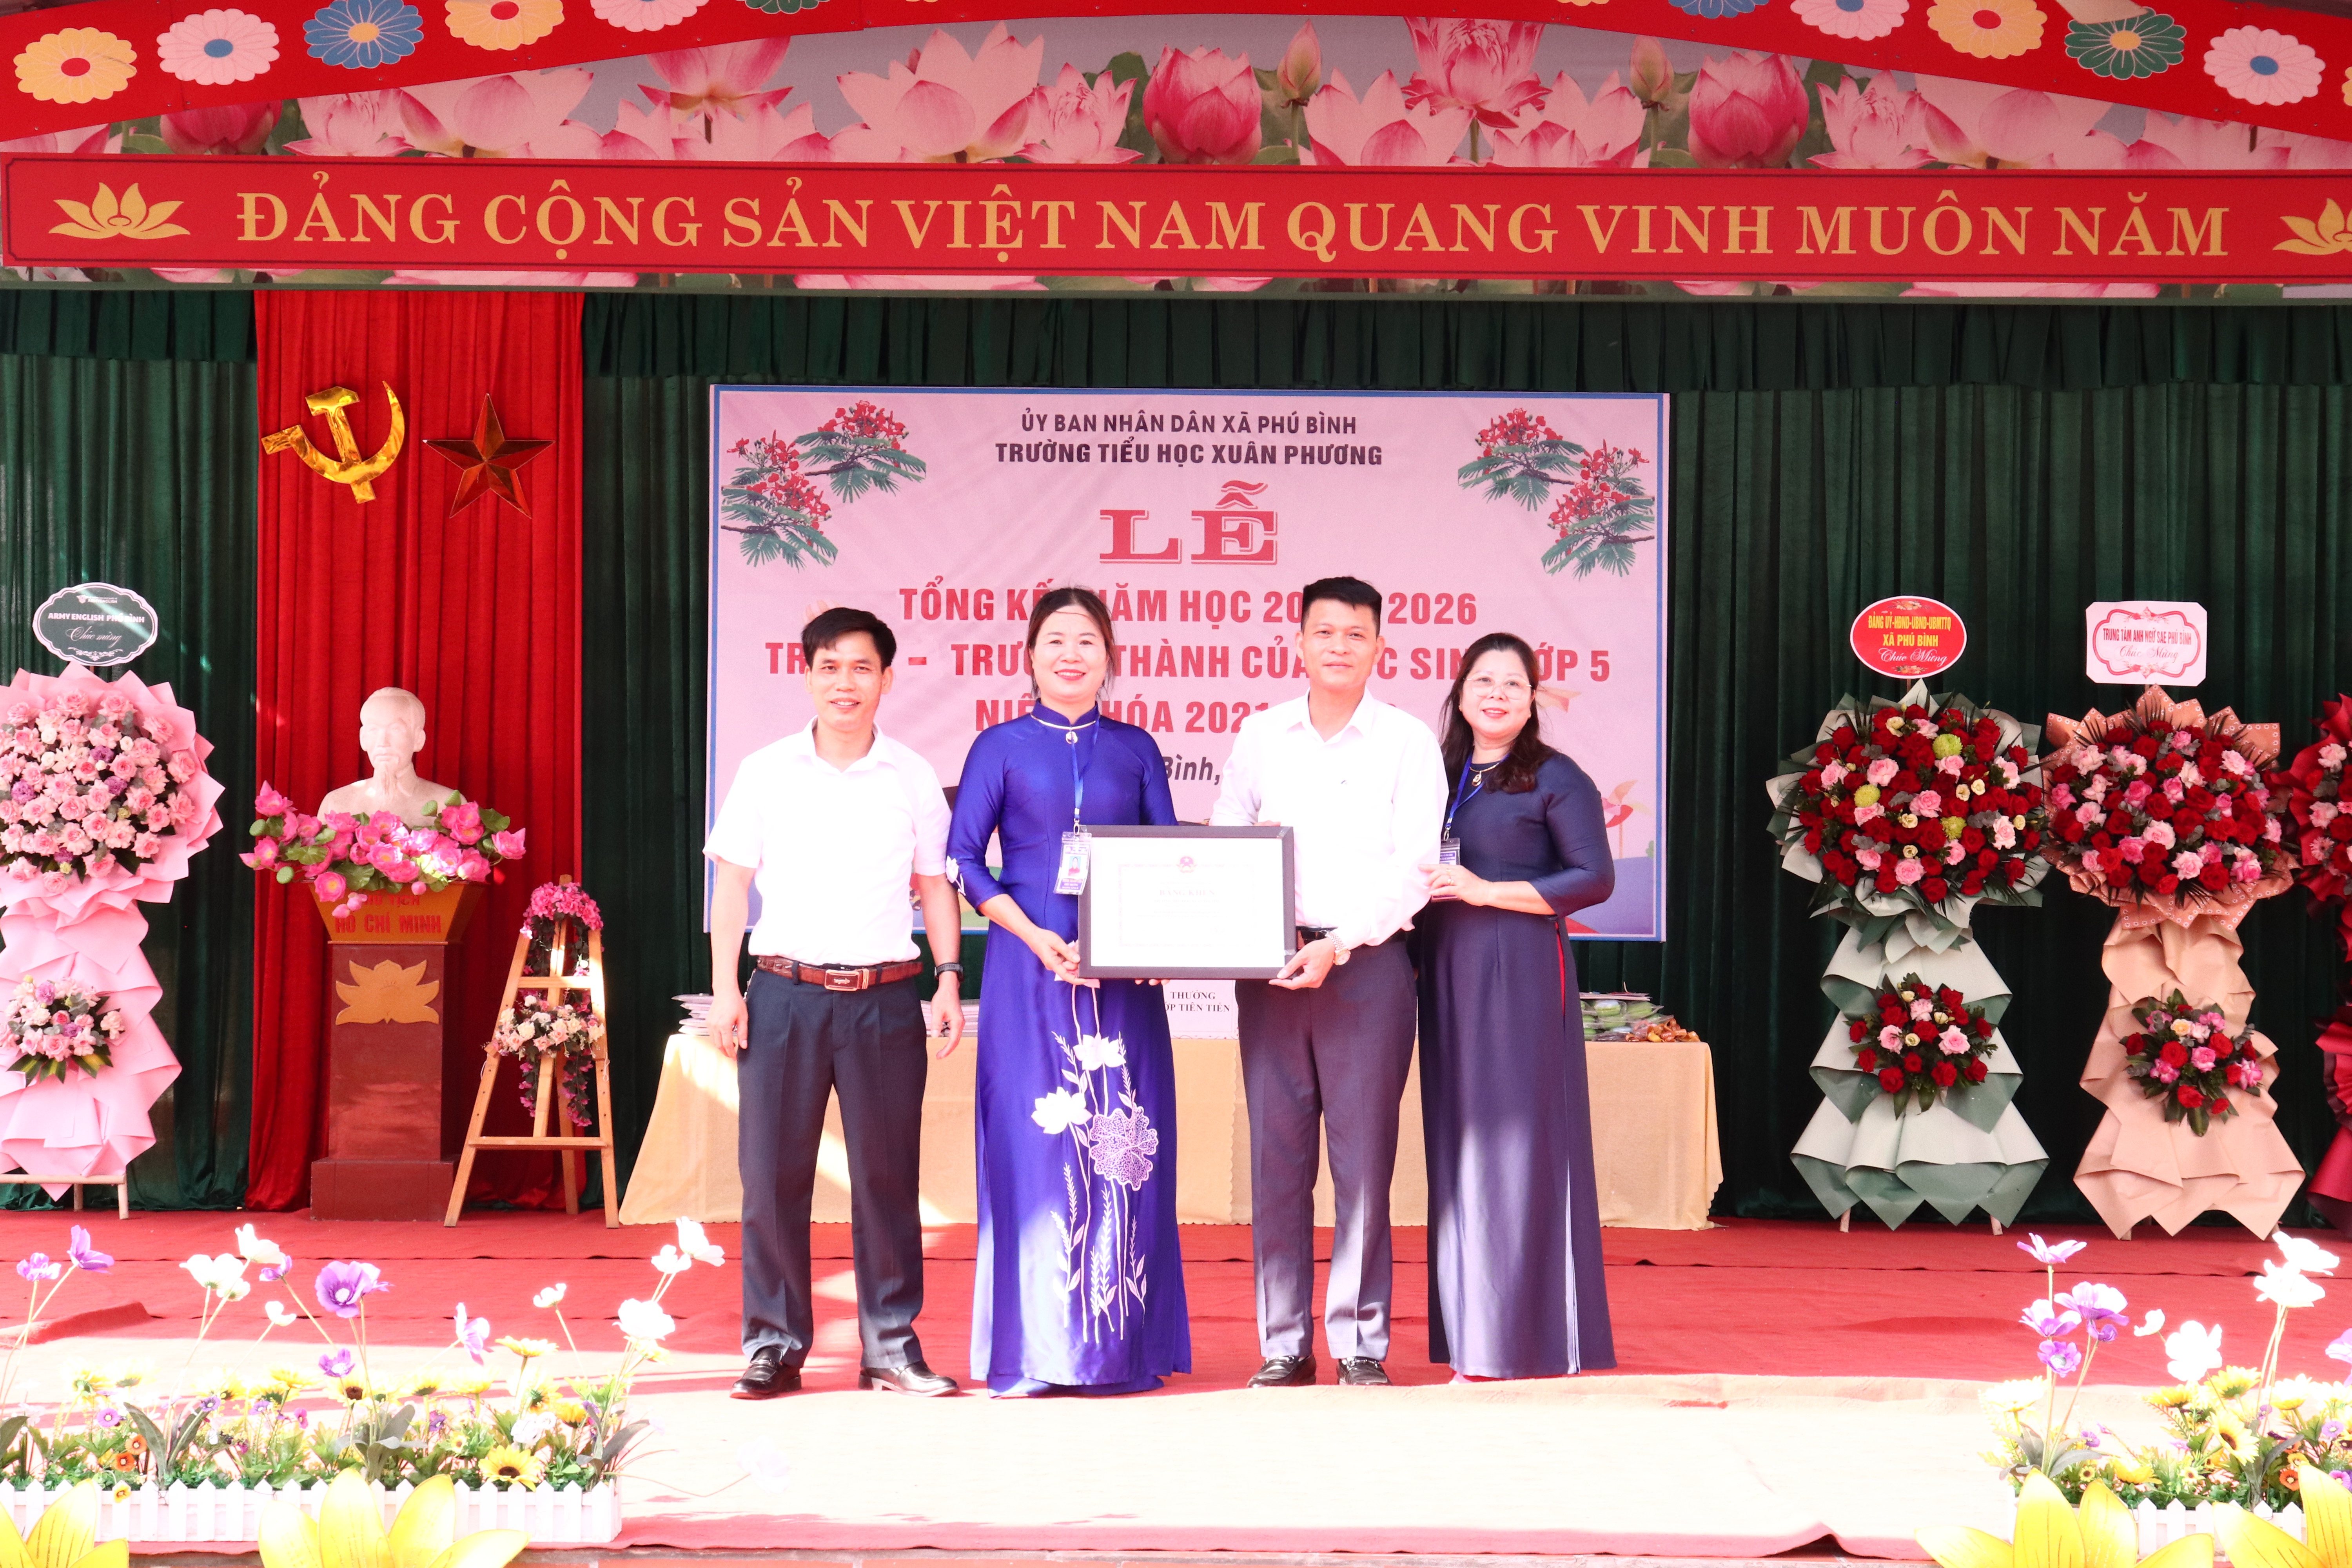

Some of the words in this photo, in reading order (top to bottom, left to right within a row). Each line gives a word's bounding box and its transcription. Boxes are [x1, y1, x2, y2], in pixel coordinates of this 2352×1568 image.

[237, 171, 460, 243] ĐẢNG
[484, 179, 702, 260] CỘNG
[724, 177, 873, 247] SẢN
[891, 184, 1075, 263] VIỆT
[1096, 201, 1265, 249] NAM
[1287, 202, 1558, 263] QUANG
[1577, 205, 1774, 254] VINH
[1796, 190, 2033, 255] MUÔN
[2053, 192, 2228, 256] NĂM
[1022, 408, 1048, 432] ỦY
[1054, 414, 1096, 432] BAN
[1103, 410, 1164, 432] NHÂN
[1171, 410, 1215, 432] DÂN
[1222, 411, 1252, 433] XÃ
[1258, 411, 1299, 434] PHÚ
[1306, 411, 1356, 434] BÌNH
[995, 438, 1091, 463] TRƯỜNG
[1097, 436, 1149, 463] TIỂU
[1157, 444, 1204, 467] HỌC
[1211, 441, 1276, 464] XUÂN
[1284, 444, 1382, 465] PHƯƠNG
[1099, 480, 1278, 565] LỄ
[899, 575, 995, 621] TỔNG
[1180, 590, 1251, 630] HỌC
[1388, 592, 1477, 625] 2026
[47, 612, 70, 620] ARMY
[106, 612, 124, 622] PHÚ
[1868, 611, 1884, 629] ĐẢNG
[1882, 632, 1895, 646] XÃ
[1897, 632, 1915, 646] PHÚ
[1917, 632, 1939, 647] BÌNH
[2103, 628, 2120, 641] TRUNG
[2133, 629, 2144, 642] ANH
[2157, 630, 2167, 644] SAE
[2168, 629, 2178, 645] PHÚ
[2179, 629, 2192, 645] BÌNH
[1533, 642, 1578, 682] ỚP
[1590, 650, 1610, 682] 5
[1878, 648, 1907, 662] Chúc
[1101, 693, 1174, 733] HÓA
[363, 911, 391, 933] CHÍ
[399, 915, 442, 933] MINH
[1170, 989, 1216, 1000] THƯỞNG
[1178, 1002, 1203, 1011] TIÊN
